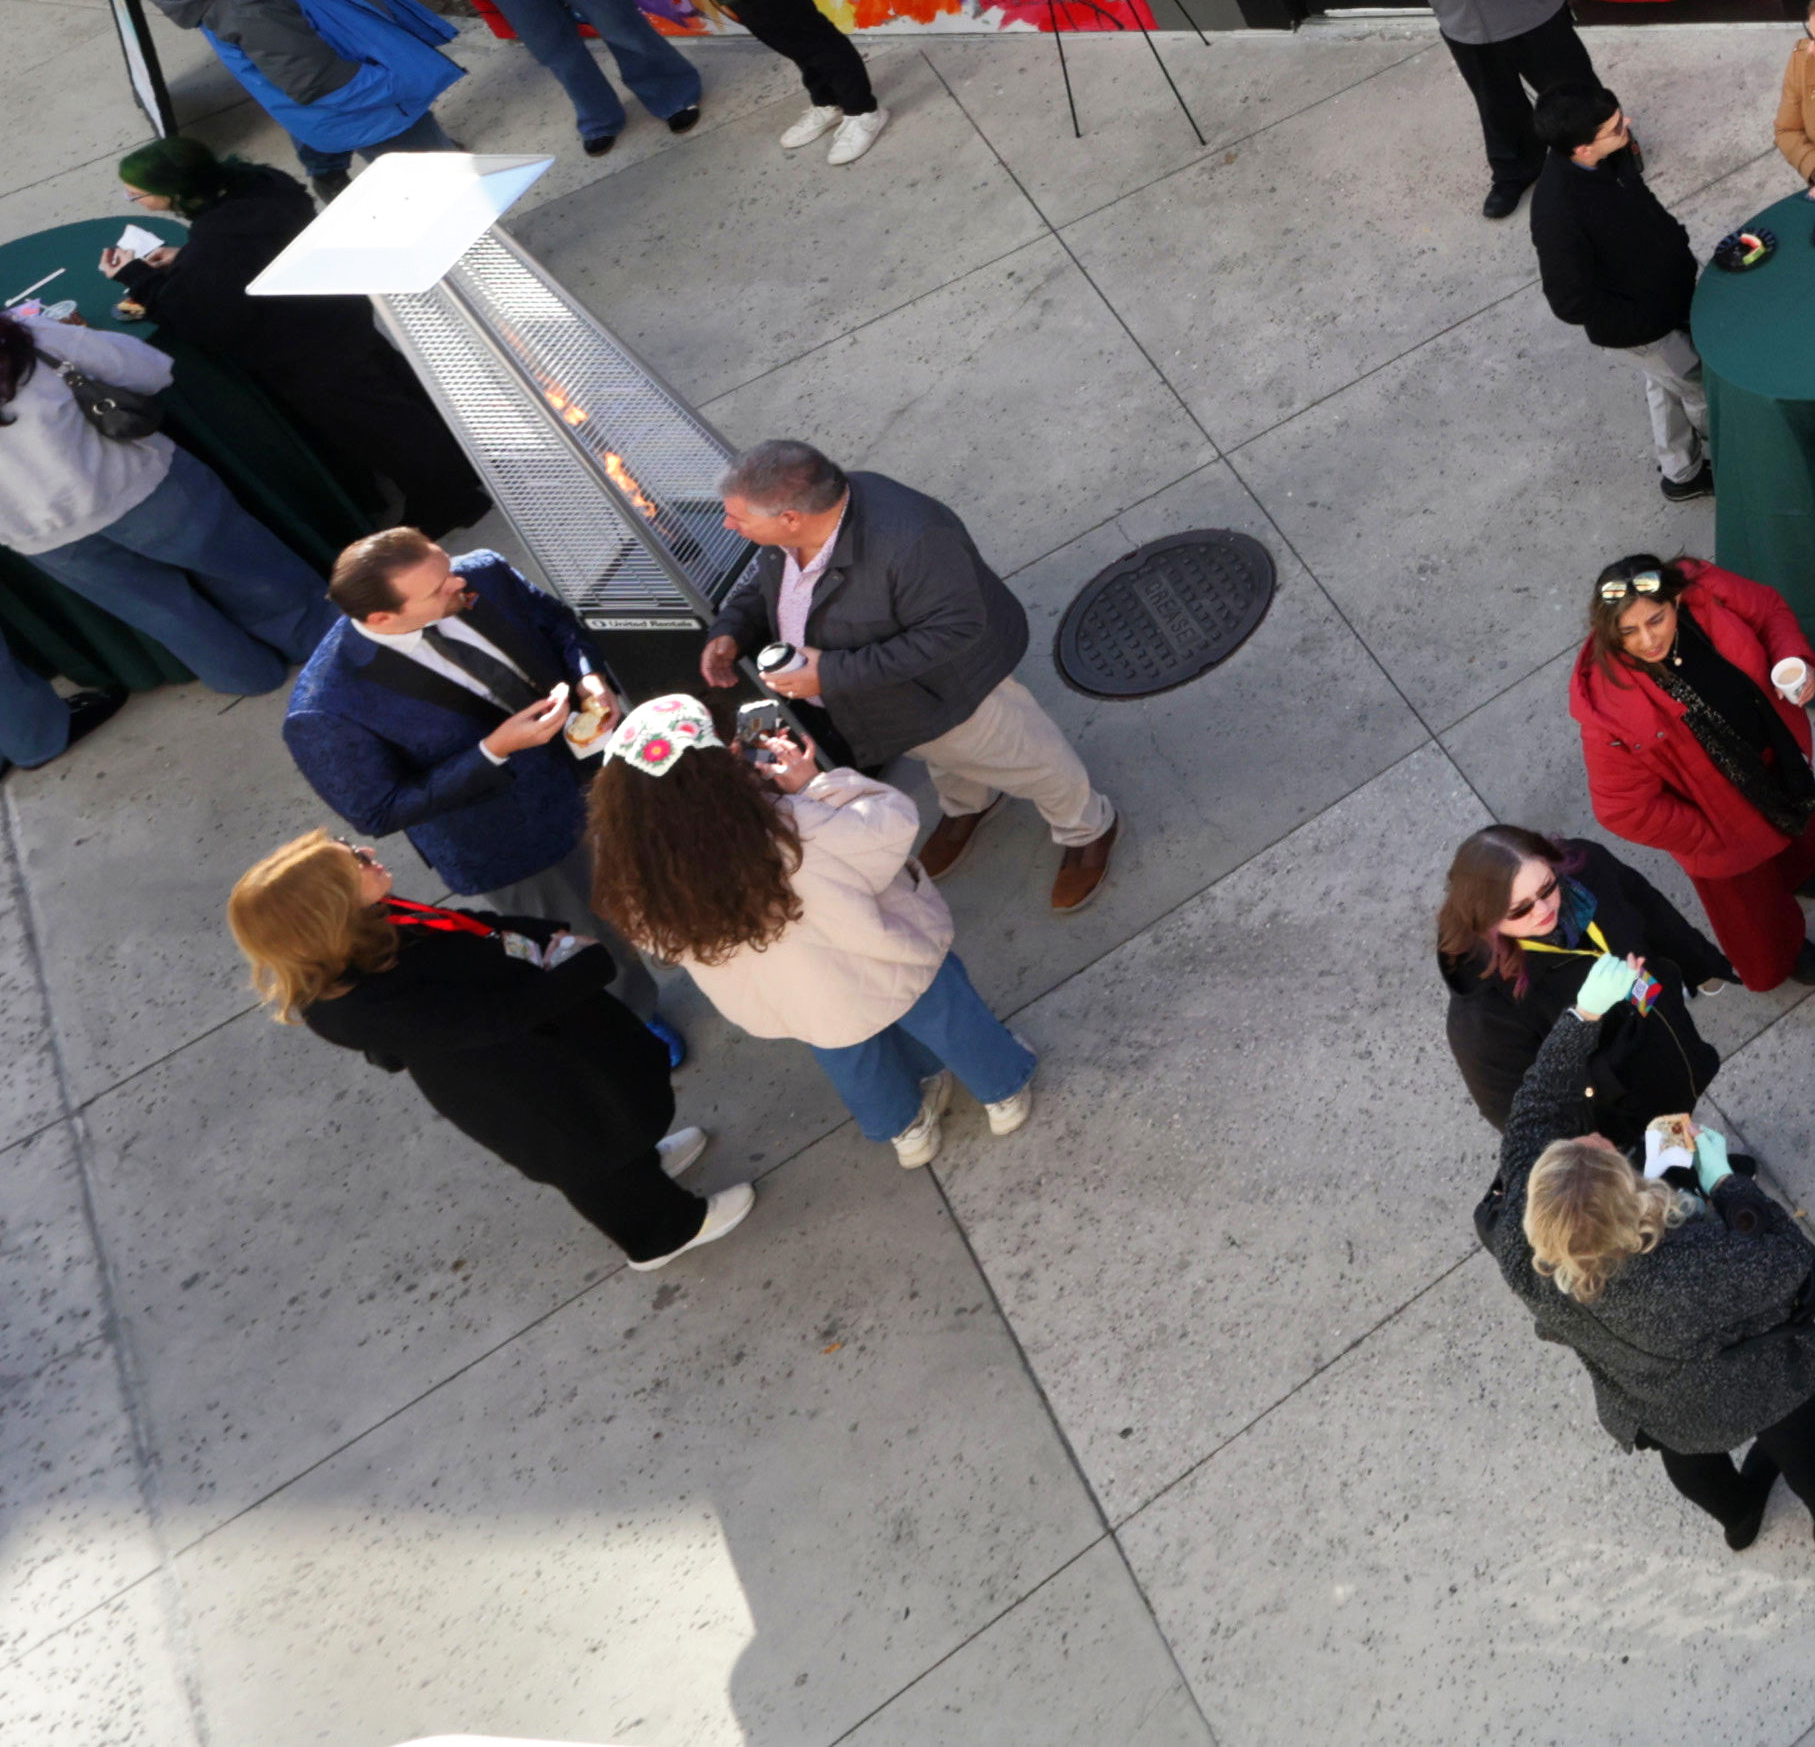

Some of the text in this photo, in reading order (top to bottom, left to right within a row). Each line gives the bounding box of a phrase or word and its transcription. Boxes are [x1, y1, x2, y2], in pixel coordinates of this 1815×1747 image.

[608, 620, 693, 629] United Rentals
[1144, 581, 1197, 644] GREASE
